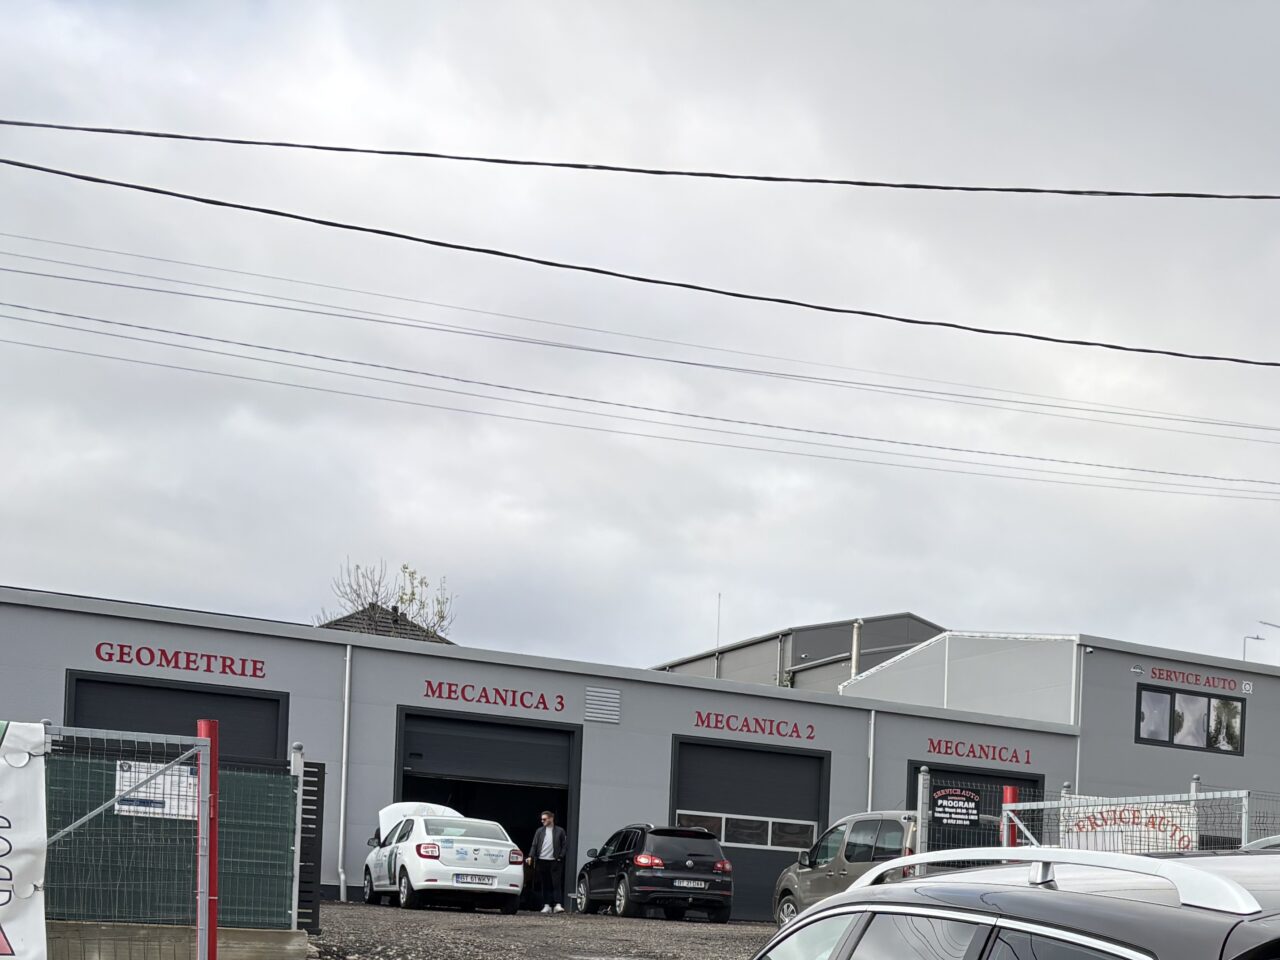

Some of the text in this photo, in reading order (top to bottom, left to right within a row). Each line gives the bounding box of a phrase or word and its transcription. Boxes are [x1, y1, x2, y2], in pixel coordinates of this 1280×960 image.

[95, 642, 267, 679] GEOMETRIE
[1150, 667, 1237, 691] SERVICE AUTO
[423, 680, 566, 712] MECANICA 3
[694, 711, 816, 740] MECANICA 2
[927, 738, 1031, 764] MECANICA 1
[933, 788, 961, 799] SERVICE
[962, 790, 980, 801] AUTO
[937, 799, 976, 808] PROGRAM
[1066, 809, 1193, 850] ERVICE AUTO
